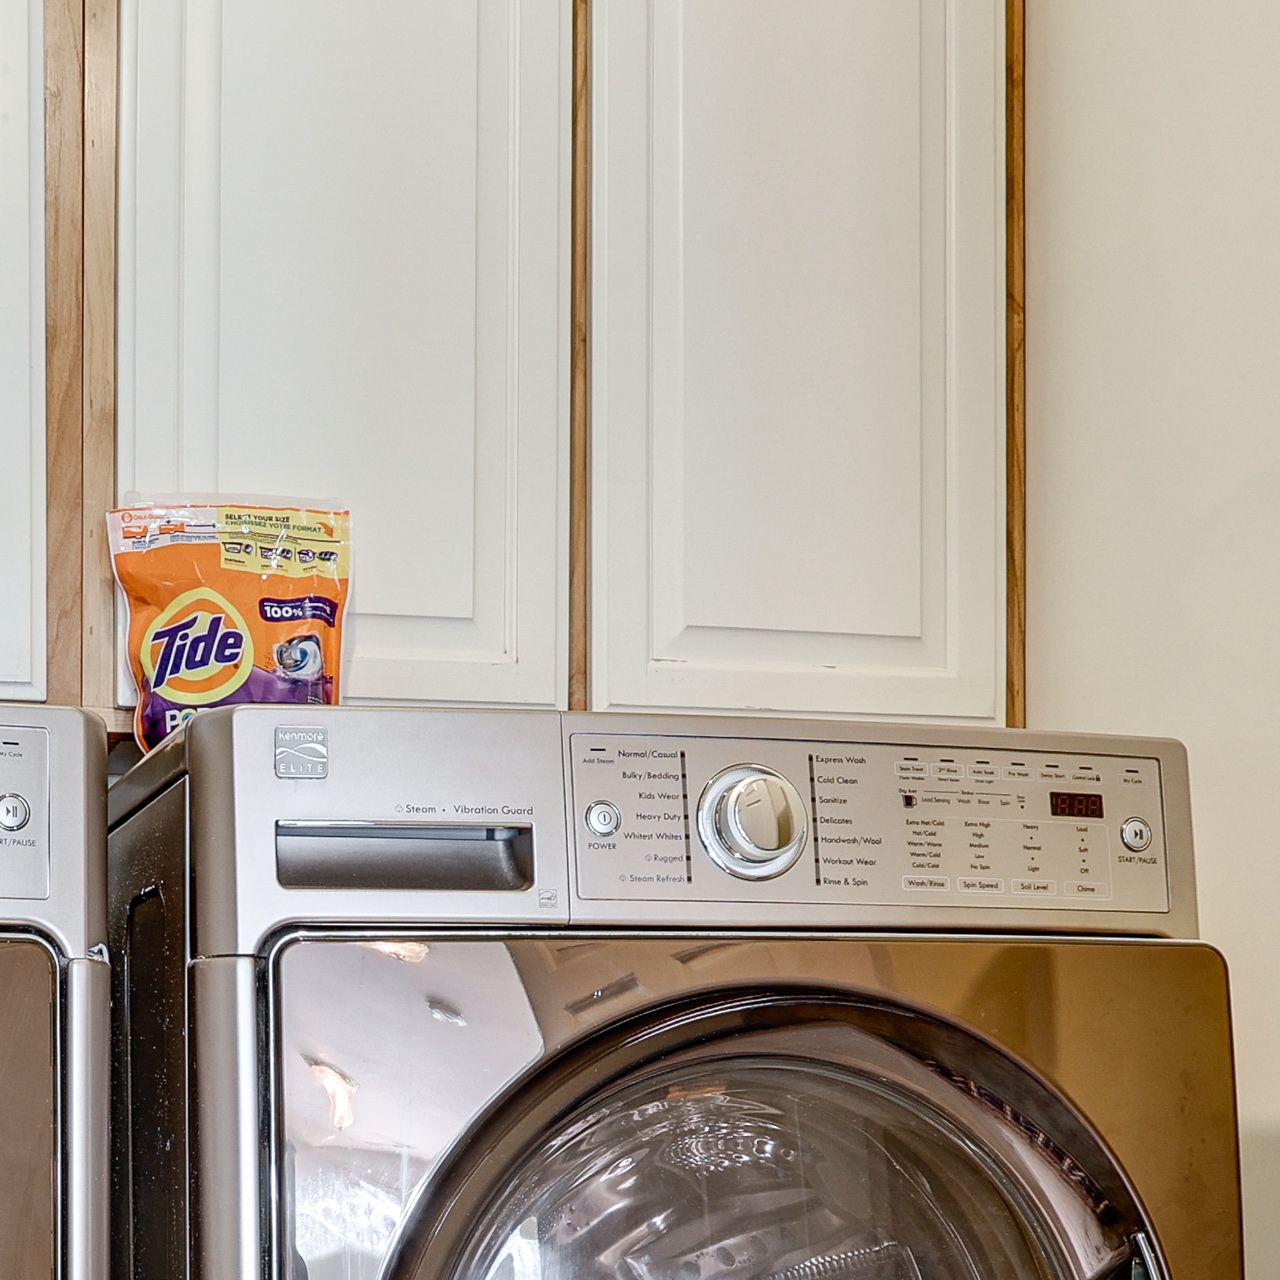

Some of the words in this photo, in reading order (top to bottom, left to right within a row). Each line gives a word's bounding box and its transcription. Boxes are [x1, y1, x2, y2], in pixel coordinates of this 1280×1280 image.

[292, 525, 322, 533] FORMAT
[264, 606, 303, 618] 100%
[150, 614, 245, 692] Tide
[278, 732, 324, 740] Kenmore
[618, 750, 678, 758] Normal/Casual
[816, 755, 843, 764] Express
[846, 756, 866, 764] Wash
[280, 764, 323, 772] ELITE
[622, 772, 680, 781] Bulky/Bedding
[638, 792, 656, 800] Kids
[819, 796, 848, 804] Sanitize
[405, 804, 436, 814] Steam
[453, 804, 499, 815] Vibration
[502, 805, 534, 816] Guard
[636, 813, 662, 821] Heavy
[664, 814, 682, 822] Duty
[822, 837, 882, 845] Handwash/Wool
[654, 854, 684, 864] Rugged
[856, 858, 876, 866] Wear
[1118, 856, 1158, 864] START/PAUSE
[852, 878, 868, 886] Spin
[908, 880, 945, 888] Wash/Rinse
